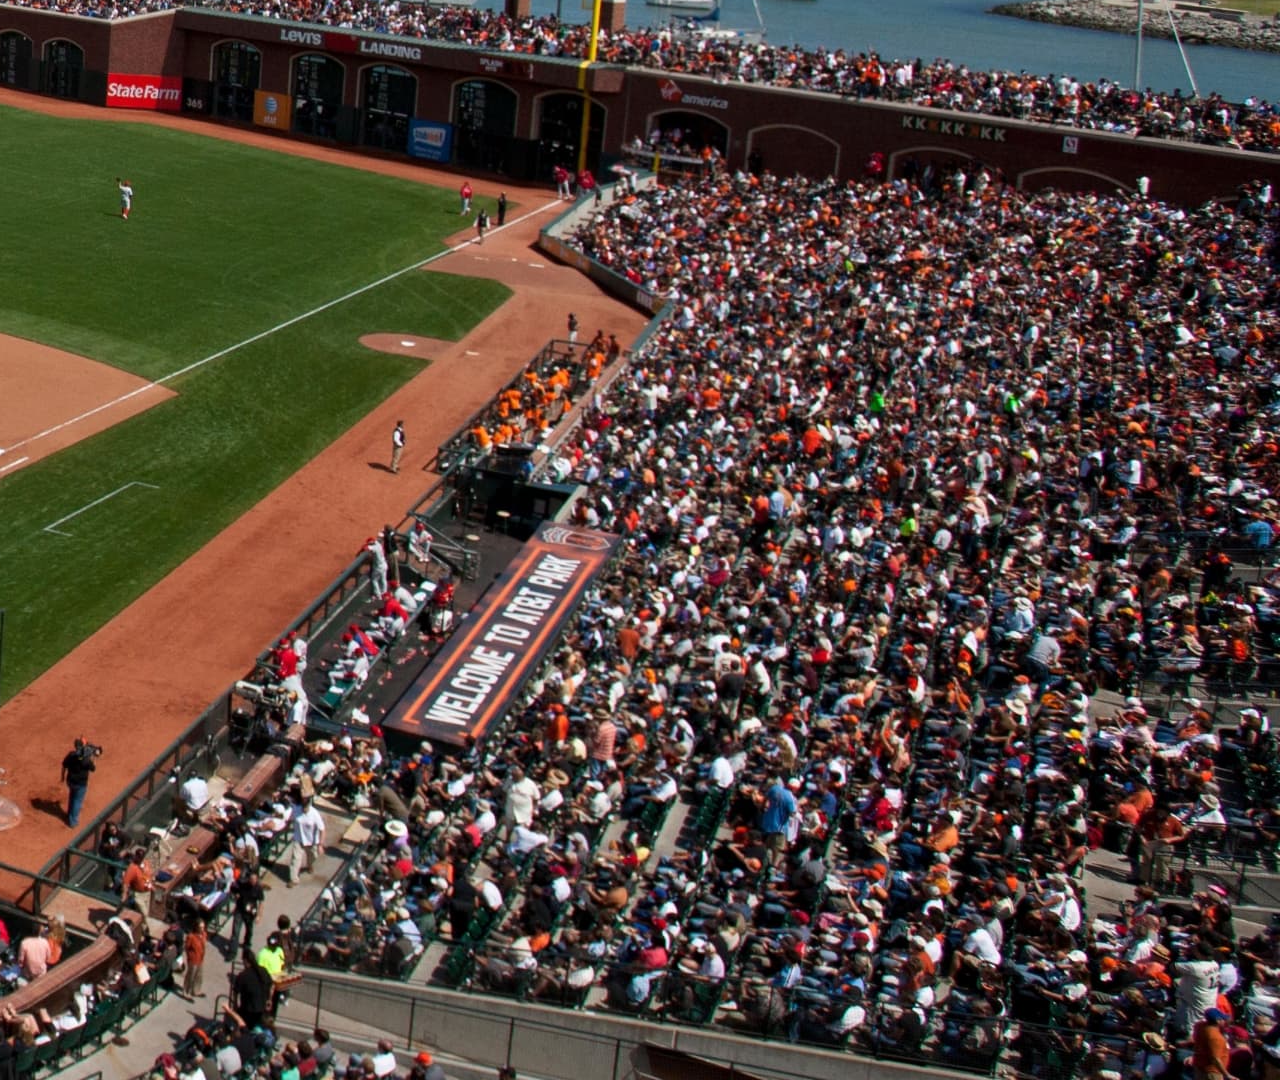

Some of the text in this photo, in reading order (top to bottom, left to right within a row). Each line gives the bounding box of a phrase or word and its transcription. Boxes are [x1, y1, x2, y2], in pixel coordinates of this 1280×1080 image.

[360, 41, 421, 60] LANDING
[107, 82, 180, 100] State Farm
[187, 98, 203, 109] 365
[681, 93, 728, 110] america
[424, 553, 582, 727] WELCOME TO AT&T PARK
